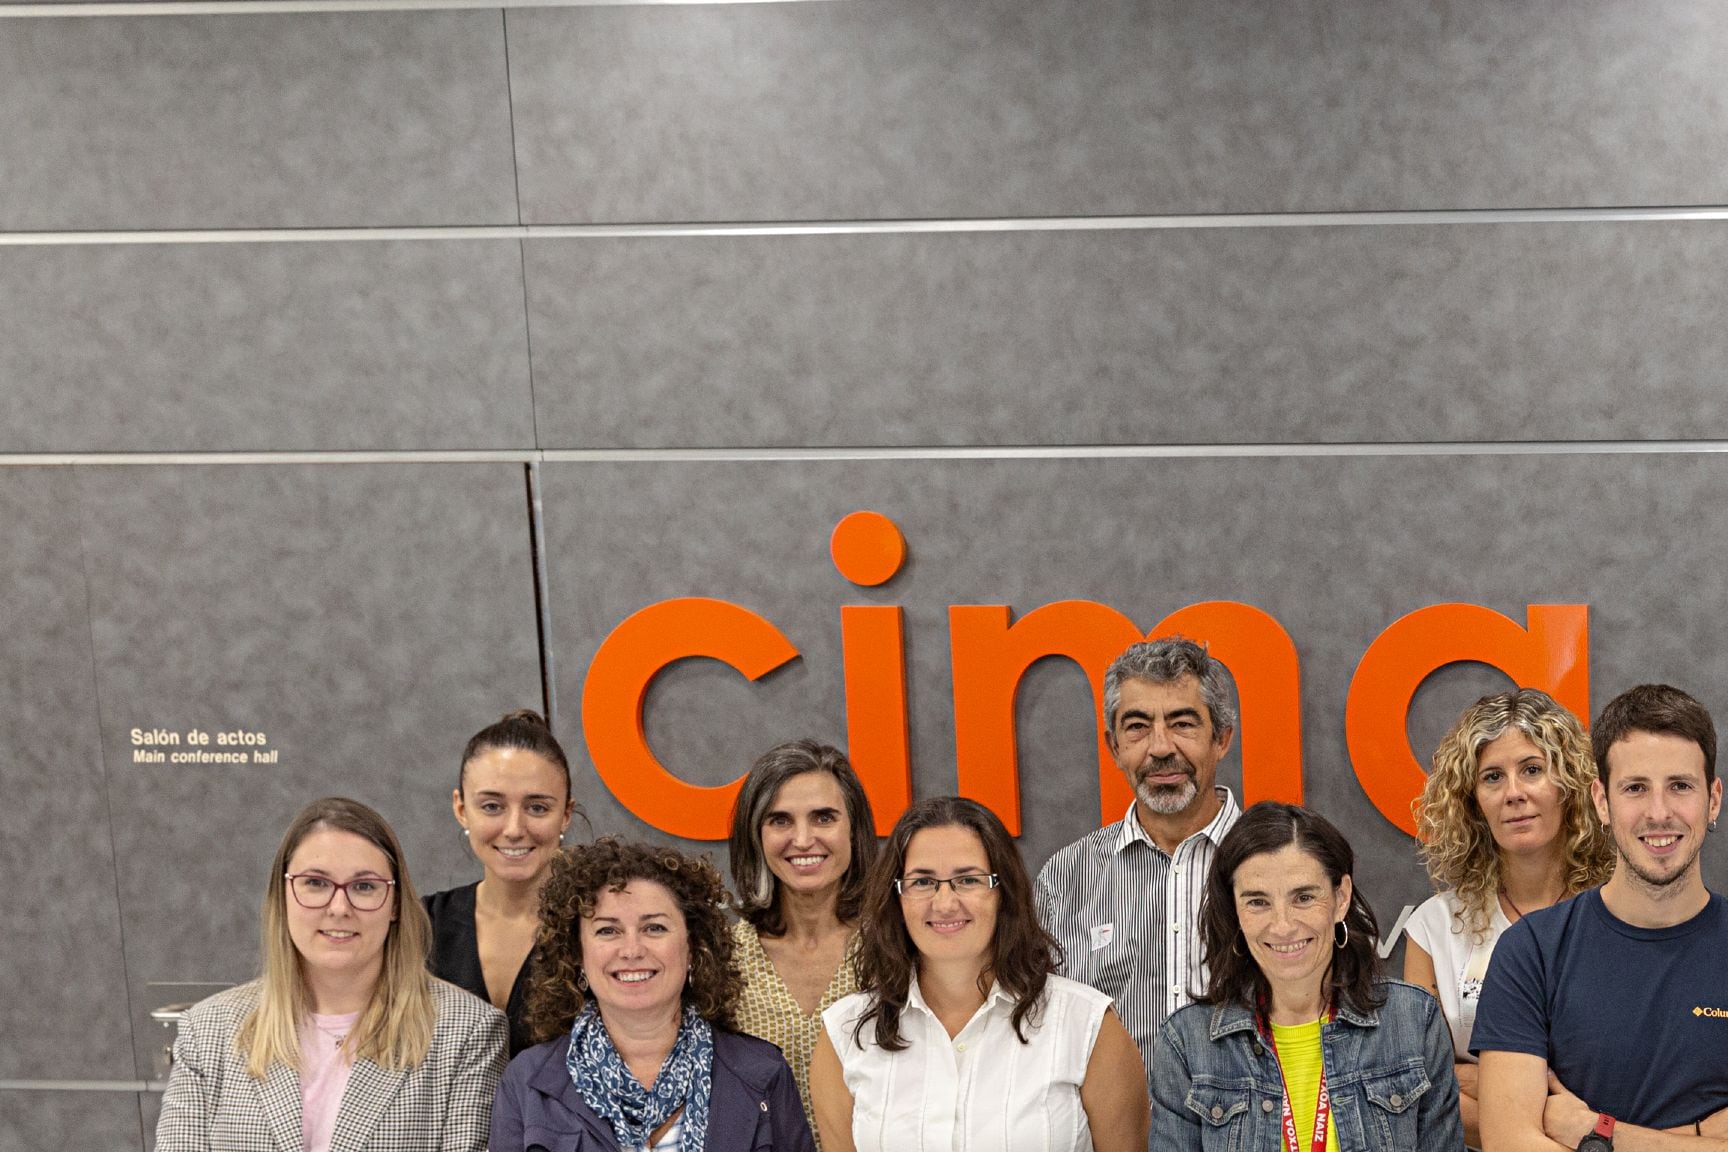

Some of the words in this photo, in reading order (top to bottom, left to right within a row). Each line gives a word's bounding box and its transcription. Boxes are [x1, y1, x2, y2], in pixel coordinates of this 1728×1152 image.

[582, 511, 1590, 842] cima
[131, 728, 180, 745] Salón
[187, 728, 209, 745] de
[217, 729, 267, 745] actos
[133, 750, 165, 763] Main
[170, 750, 248, 763] conference
[253, 750, 278, 763] hall
[1314, 1113, 1327, 1142] NAIZ
